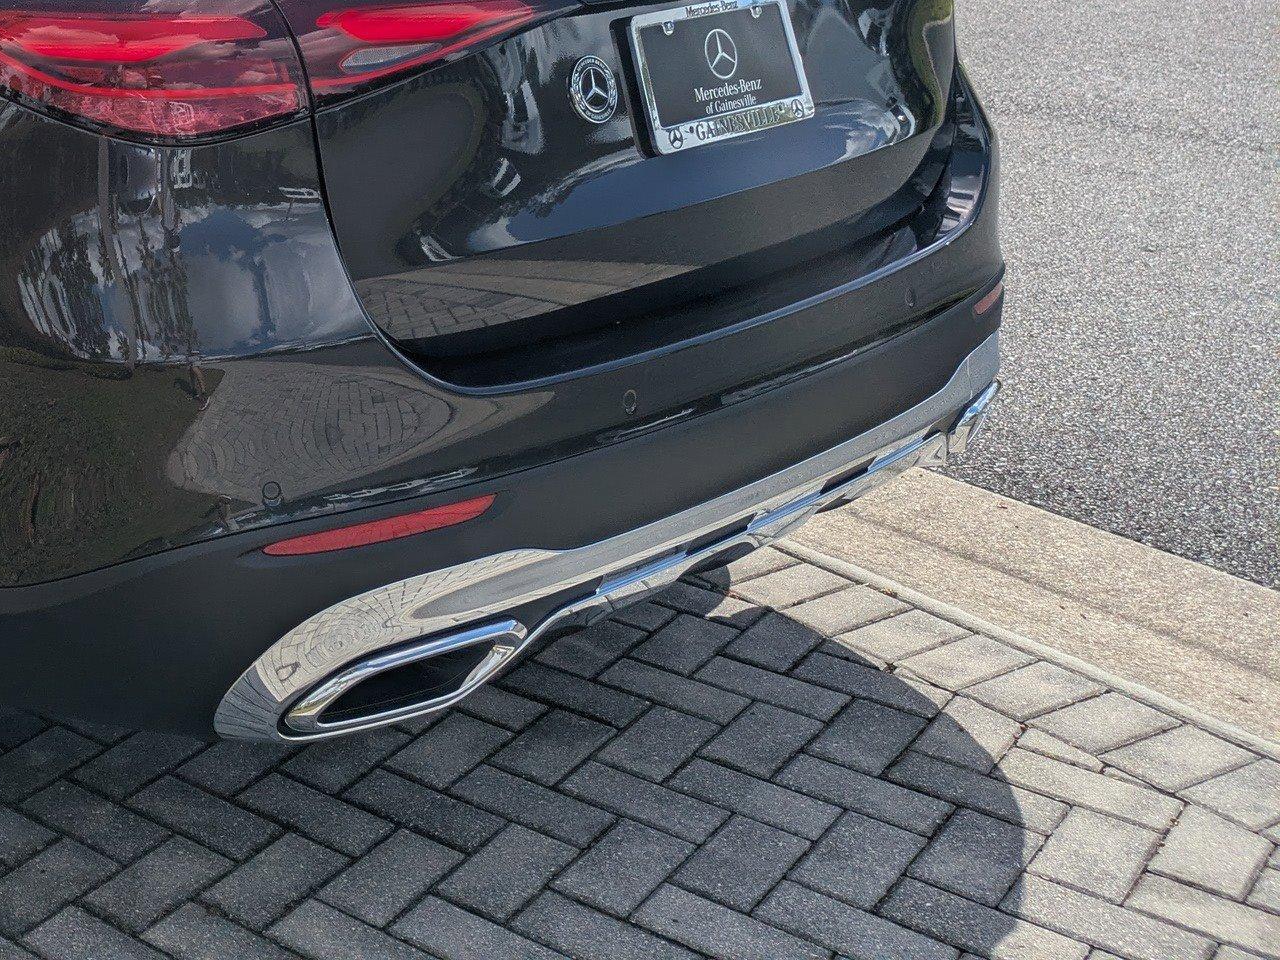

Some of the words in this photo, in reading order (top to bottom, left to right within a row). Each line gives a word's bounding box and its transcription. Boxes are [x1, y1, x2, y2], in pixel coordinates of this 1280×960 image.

[684, 0, 739, 18] Mercedes-Benz
[693, 78, 763, 103] Mercedes-Benz
[705, 102, 715, 115] of
[714, 93, 757, 113] Gainesville
[695, 104, 781, 141] GAINESVILLE
